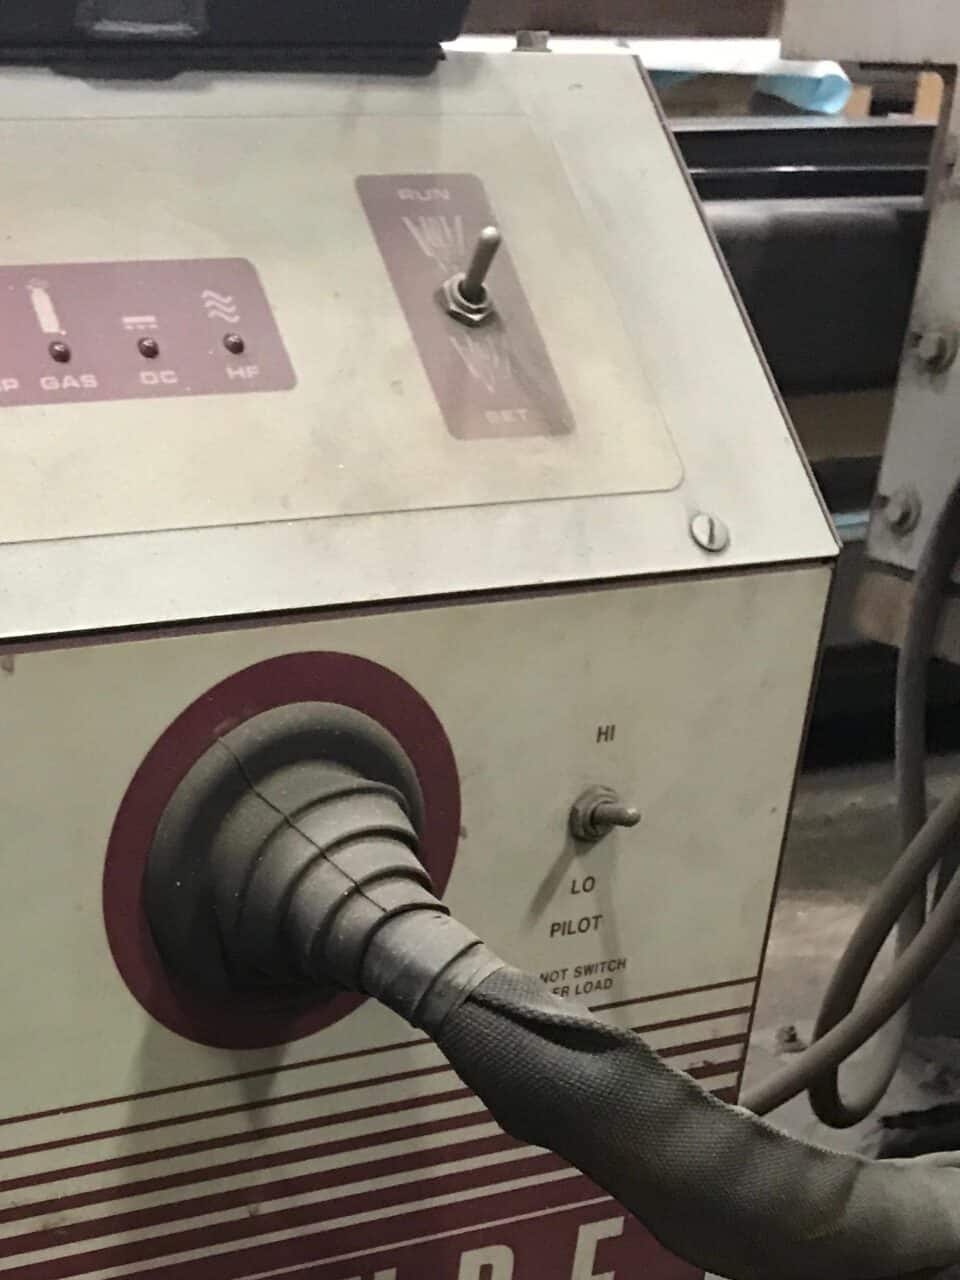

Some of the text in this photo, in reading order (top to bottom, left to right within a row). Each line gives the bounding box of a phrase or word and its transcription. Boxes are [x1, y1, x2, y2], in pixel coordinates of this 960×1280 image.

[40, 374, 98, 391] GAS
[140, 370, 178, 386] DC
[226, 365, 261, 380] HF
[595, 724, 617, 743] HI
[570, 875, 596, 895] LO
[549, 914, 604, 938] PILOT
[574, 957, 627, 979] SWITCH
[575, 978, 614, 996] LOAD
